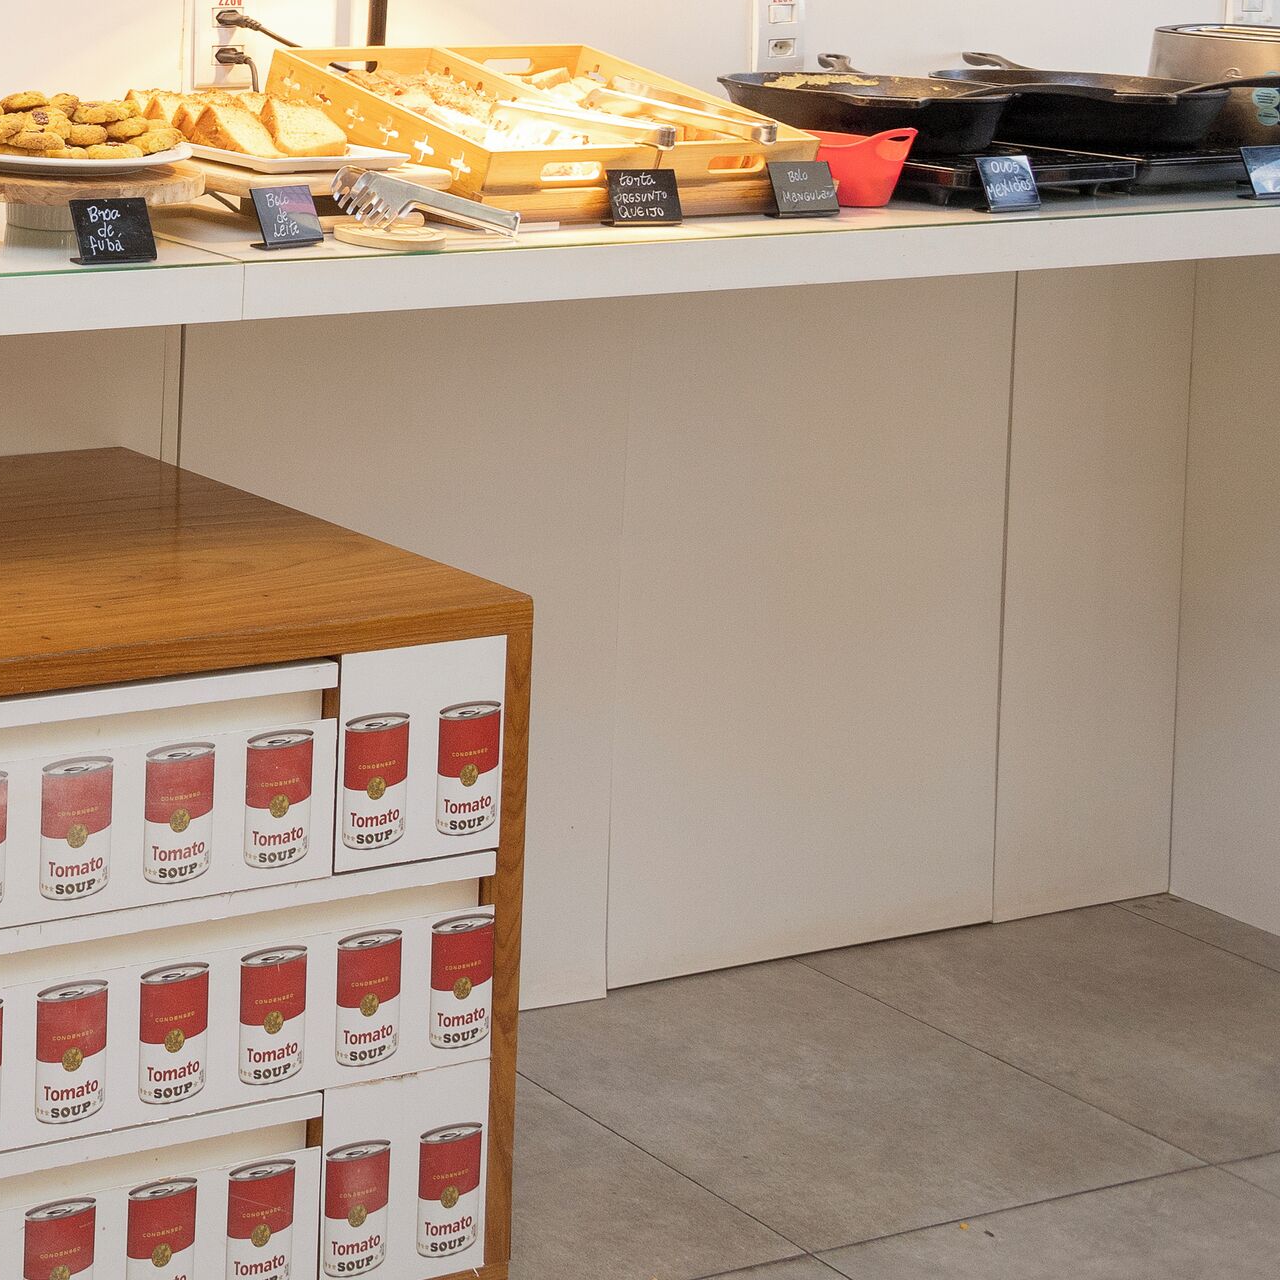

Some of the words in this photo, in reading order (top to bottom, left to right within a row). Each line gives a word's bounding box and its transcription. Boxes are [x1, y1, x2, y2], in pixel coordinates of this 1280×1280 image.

[87, 206, 121, 223] Broa
[276, 208, 289, 223] de
[618, 205, 665, 218] QUEIJO
[97, 222, 115, 237] de
[90, 231, 125, 255] fubá
[444, 793, 492, 815] Tomato
[349, 806, 400, 829] Tomato
[450, 814, 486, 830] SOUP
[253, 824, 304, 847] Tomato
[355, 828, 394, 845] SOUP
[152, 839, 206, 862] Tomato
[259, 846, 298, 863] SOUP
[48, 854, 104, 878] Tomato
[158, 861, 199, 878] SOUP
[55, 877, 97, 894] SOUP
[437, 1006, 486, 1028] Tomato
[344, 1023, 393, 1046] Tomato
[443, 1027, 480, 1044] SOUP
[247, 1041, 298, 1063] Tomato
[350, 1045, 387, 1061] SOUP
[147, 1060, 200, 1083] Tomato
[253, 1063, 292, 1080] SOUP
[44, 1078, 99, 1101] Tomato
[153, 1082, 193, 1099] SOUP
[50, 1100, 92, 1118] SOUP
[424, 1215, 473, 1237] Tomato
[331, 1234, 381, 1256] Tomato
[430, 1236, 467, 1253] SOUP
[235, 1255, 286, 1277] Tomato
[337, 1256, 375, 1272] SOUP
